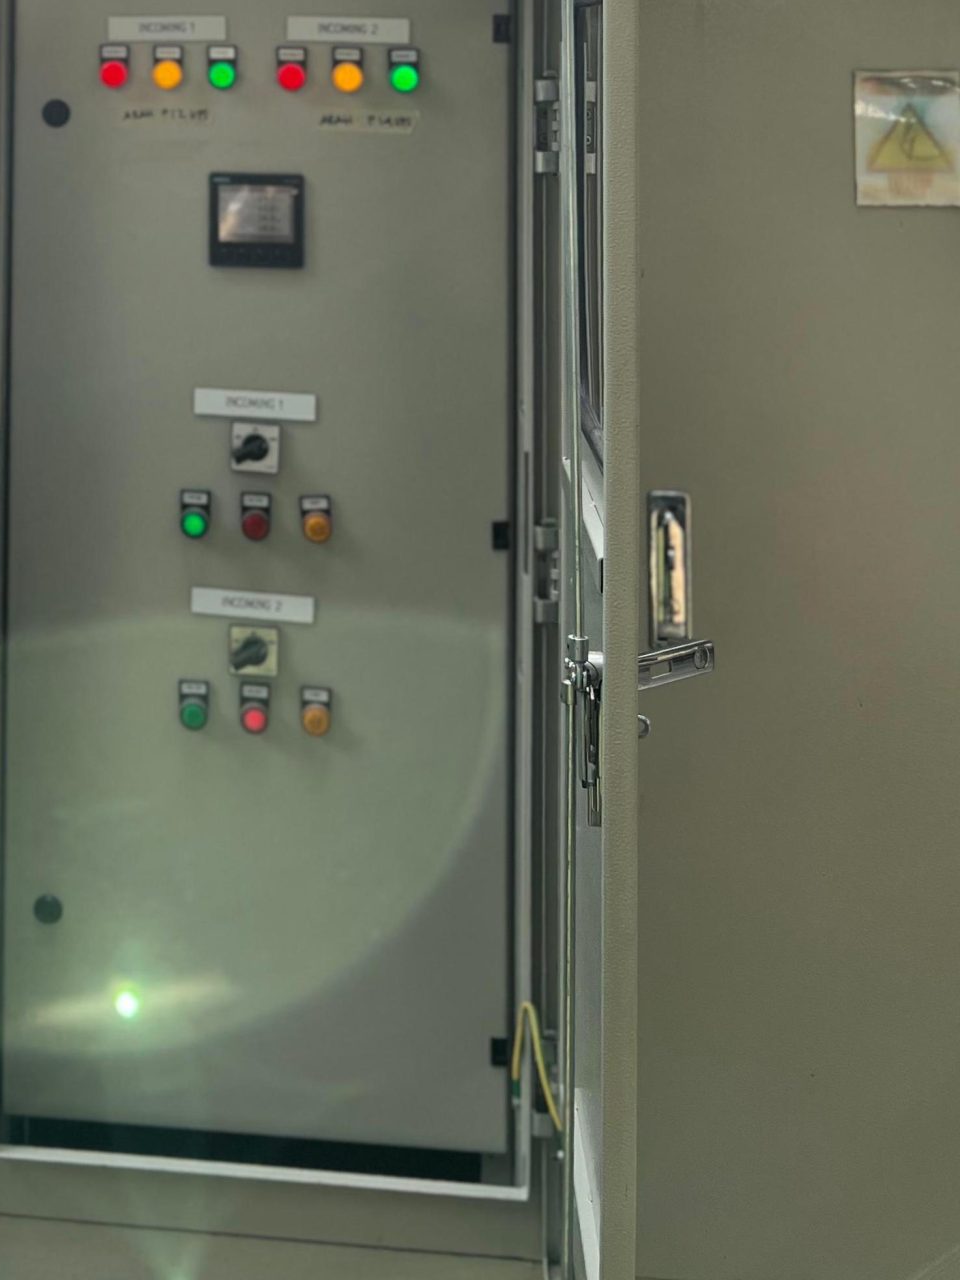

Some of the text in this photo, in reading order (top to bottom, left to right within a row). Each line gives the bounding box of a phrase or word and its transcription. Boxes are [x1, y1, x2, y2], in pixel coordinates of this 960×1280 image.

[138, 21, 187, 33] INCOMING
[318, 22, 367, 35] INCOMING
[225, 395, 275, 409] INCOMING
[221, 595, 272, 611] INCOMING
